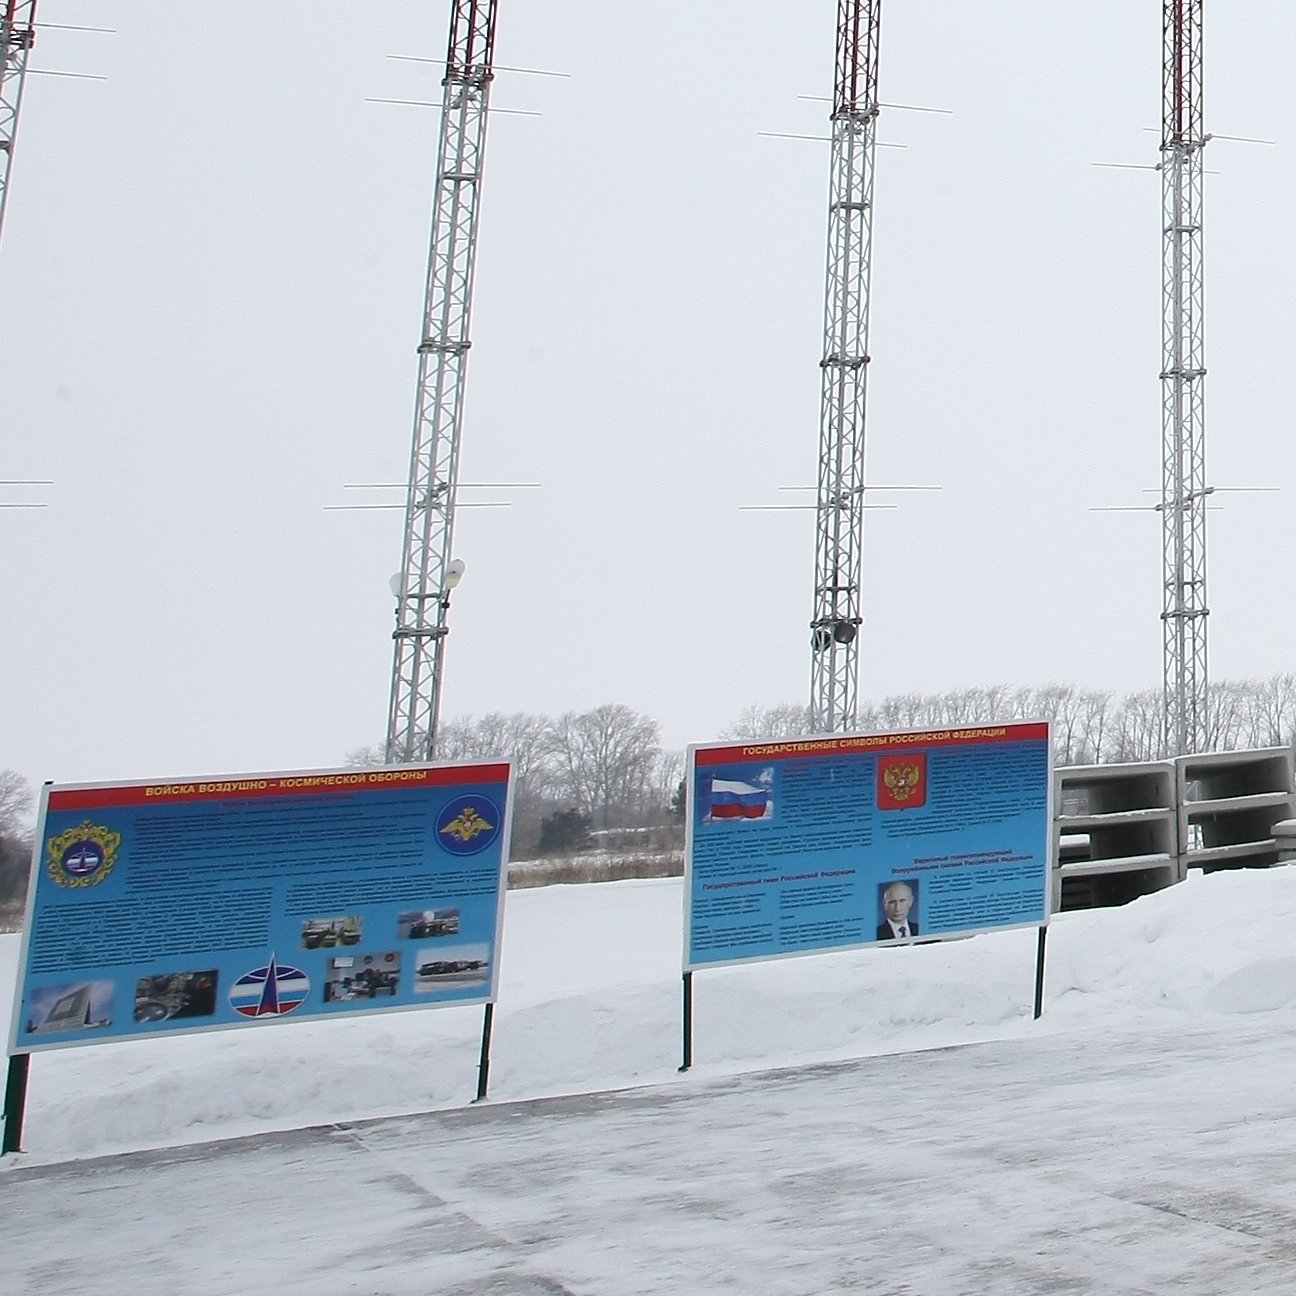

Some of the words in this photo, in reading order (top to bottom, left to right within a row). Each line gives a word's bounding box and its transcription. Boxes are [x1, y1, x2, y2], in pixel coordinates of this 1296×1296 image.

[743, 740, 837, 755] ГОСУДАРСТВЕННЫЕ
[840, 737, 887, 748] СИМВОЛЫ
[889, 731, 951, 744] РОССИЙСКОЙ
[952, 728, 1006, 739] ФЕДЕРАЦИИ
[145, 784, 195, 796] ВОЙСКА
[199, 780, 267, 793] ВОЗДУШНО
[279, 773, 366, 788] КОСМИЧЕСКОЙ
[369, 771, 426, 782] ОБОРОНЫ
